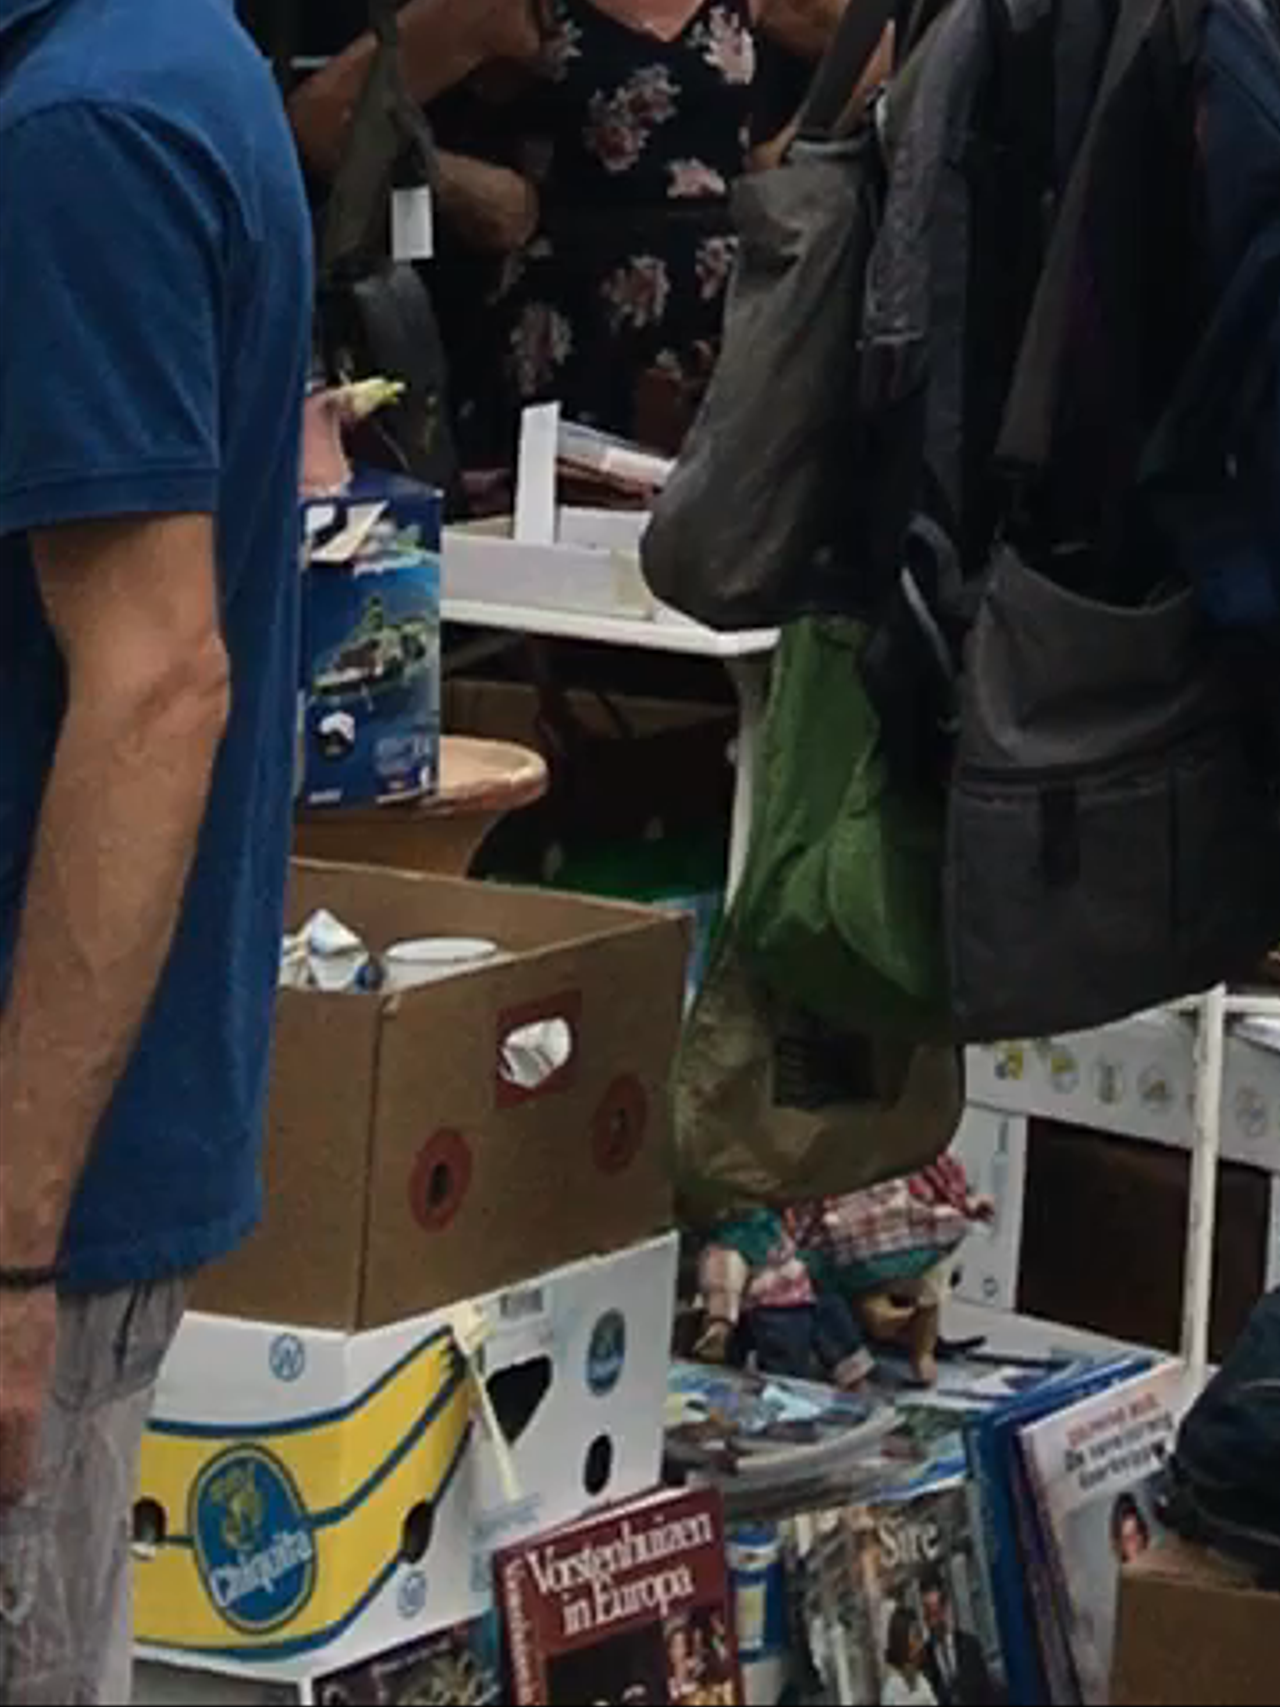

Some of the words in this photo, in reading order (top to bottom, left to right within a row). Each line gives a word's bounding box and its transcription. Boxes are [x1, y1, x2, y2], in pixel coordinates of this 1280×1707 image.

[211, 1530, 312, 1608] Chiquita
[526, 1513, 712, 1594] Vorstenhuizen
[562, 1591, 591, 1636] in
[589, 1565, 695, 1625] Europa
